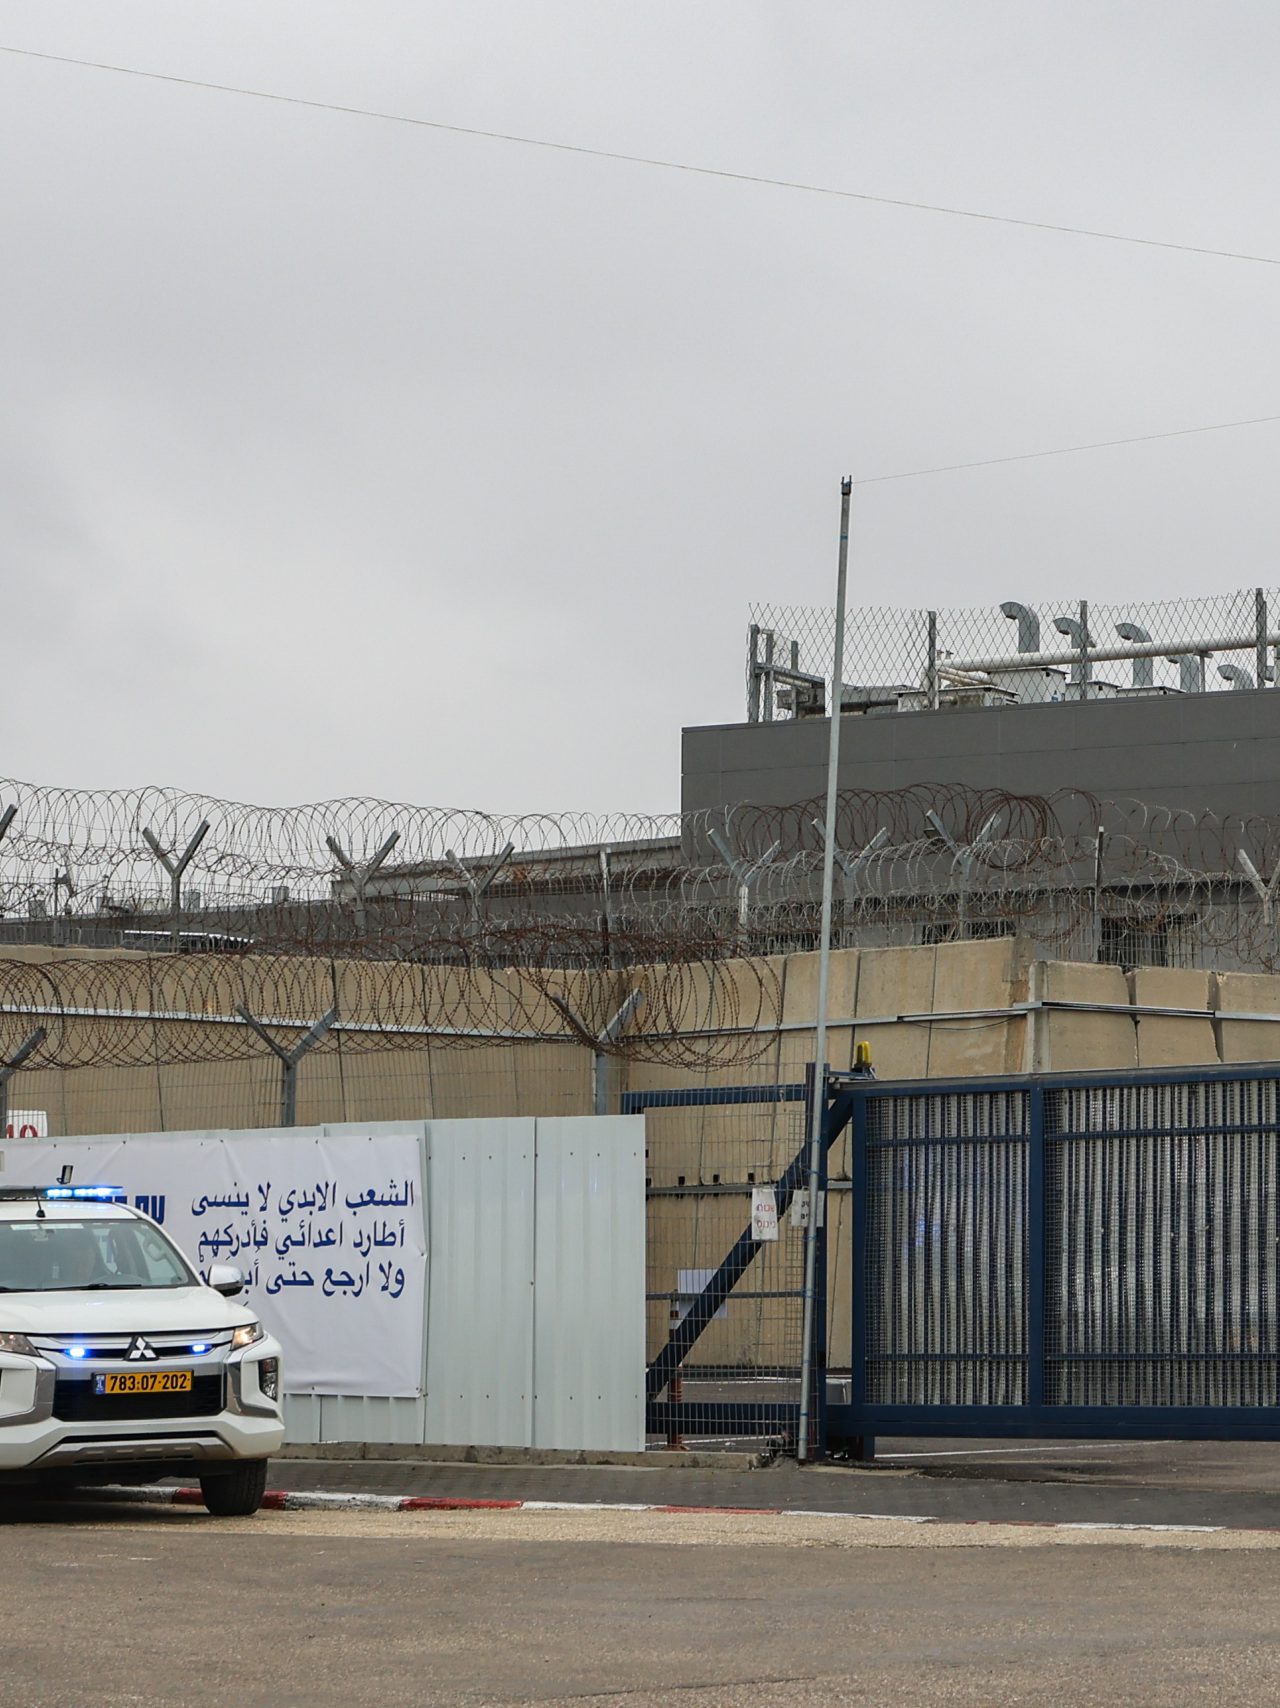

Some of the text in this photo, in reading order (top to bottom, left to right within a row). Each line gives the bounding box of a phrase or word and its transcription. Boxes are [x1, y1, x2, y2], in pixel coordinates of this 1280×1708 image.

[191, 1181, 250, 1217] ينسى
[257, 1182, 271, 1213] لا
[345, 1179, 414, 1217] الشعب
[353, 1219, 405, 1257] أطارد
[266, 1262, 315, 1295] حتى
[322, 1260, 370, 1297] ارجع
[378, 1260, 405, 1299] ولا
